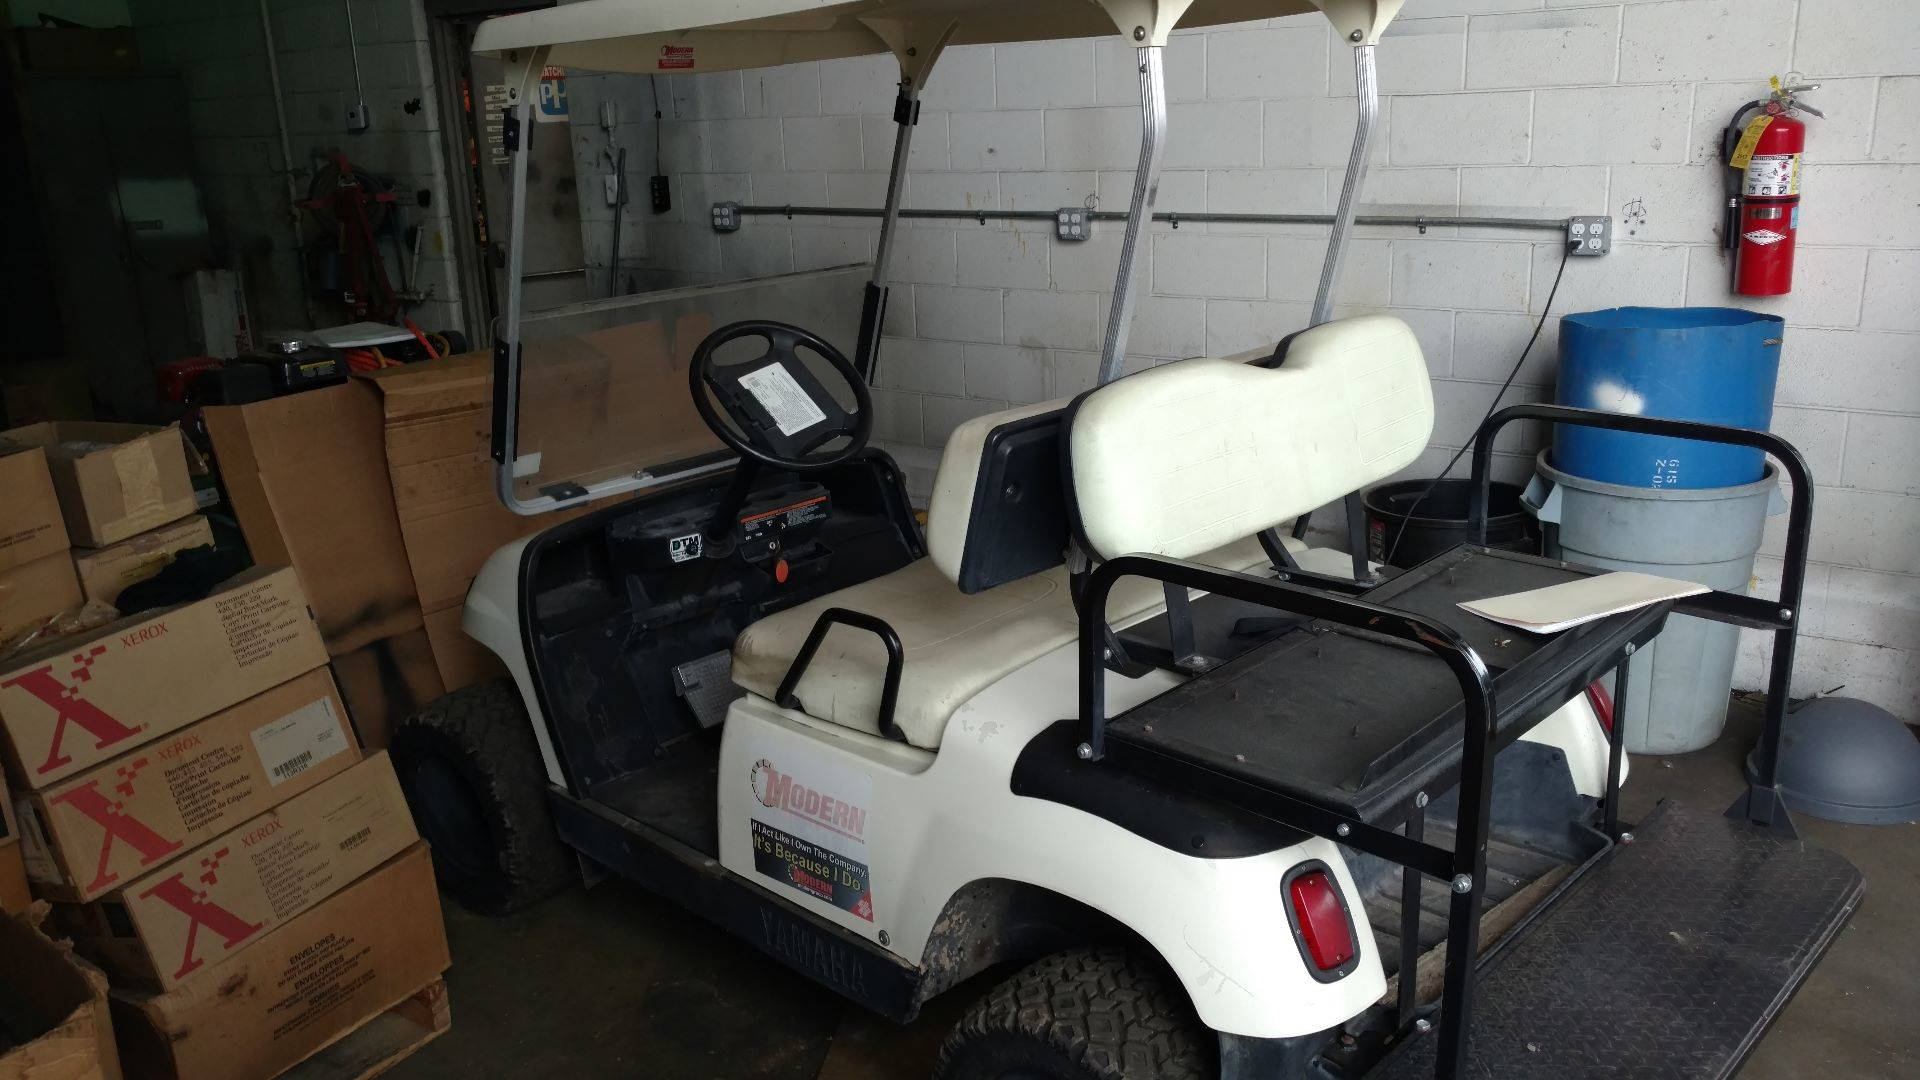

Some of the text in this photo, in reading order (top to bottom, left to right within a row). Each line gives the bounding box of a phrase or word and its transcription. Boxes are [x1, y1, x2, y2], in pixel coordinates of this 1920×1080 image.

[120, 621, 169, 649] XEROX
[157, 734, 202, 762] XEROX
[165, 757, 199, 777] Document
[209, 755, 241, 773] Cartridge
[762, 767, 867, 834] MODERN
[241, 817, 284, 847] XEROX
[762, 826, 774, 838] Act
[775, 831, 790, 845] Like
[795, 840, 812, 854] Own
[814, 847, 828, 861] The
[753, 834, 772, 854] It's
[775, 843, 830, 877] Because
[833, 869, 838, 882] I
[793, 867, 833, 894] MODERN
[289, 933, 336, 965] ENVELOPES
[760, 903, 868, 998] YAMAHA
[294, 956, 345, 990] ENVELOPPES
